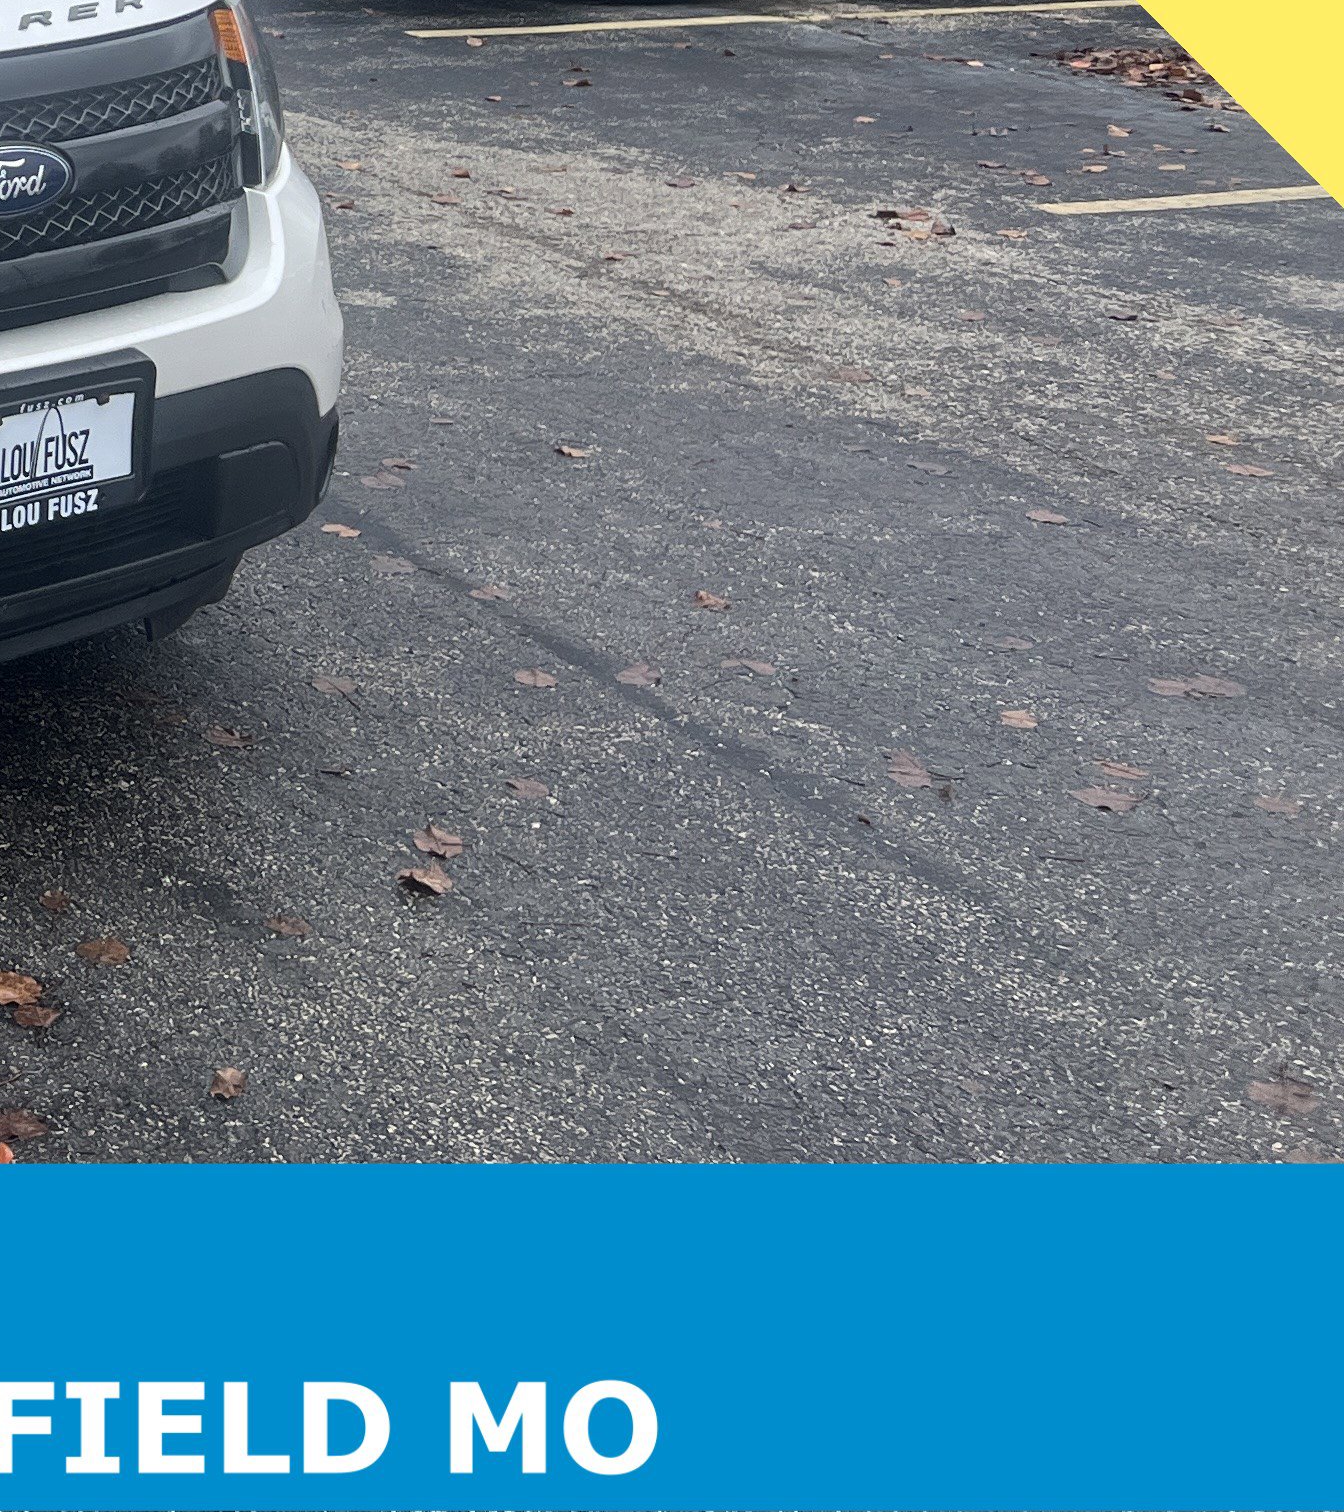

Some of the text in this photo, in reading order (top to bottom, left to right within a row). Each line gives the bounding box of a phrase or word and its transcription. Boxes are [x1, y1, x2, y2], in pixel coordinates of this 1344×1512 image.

[19, 392, 86, 414] fusz.com
[0, 428, 91, 484] LOU FUSZ
[50, 468, 93, 487] NETWORK
[0, 488, 99, 532] LOU FUSZ
